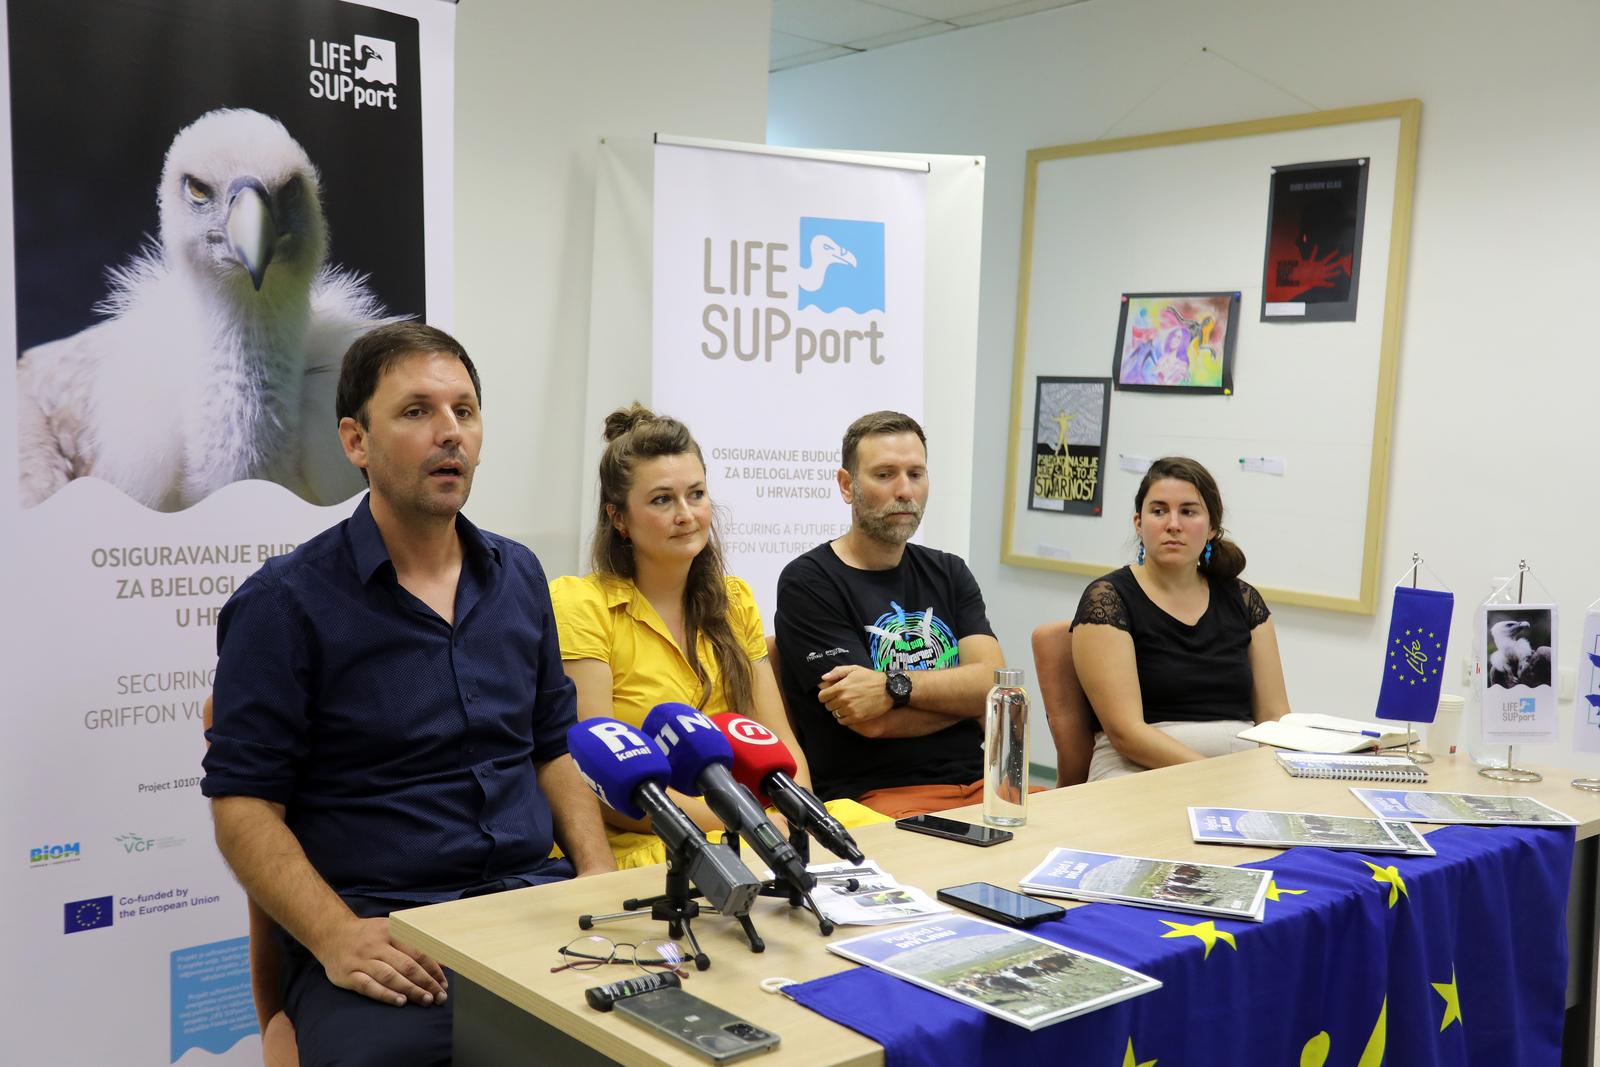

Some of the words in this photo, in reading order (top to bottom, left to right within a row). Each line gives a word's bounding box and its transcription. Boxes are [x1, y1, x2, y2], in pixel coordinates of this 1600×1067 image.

[310, 38, 352, 73] LIFE
[309, 70, 397, 110] SUPport
[704, 237, 789, 299] LIFE
[701, 303, 885, 374] SUPport
[712, 447, 798, 462] OSIGURAVANJE
[725, 467, 740, 479] ZA
[743, 467, 814, 481] BJELOGLAVE
[756, 486, 764, 498] U
[768, 486, 831, 499] HRVATSKOJ
[724, 523, 780, 536] SECURING
[783, 523, 792, 535] A
[794, 523, 836, 536] FUTURE
[91, 544, 251, 569] OSIGURAVANJE
[116, 579, 144, 600] ZA
[176, 608, 190, 627] U
[84, 702, 176, 730] GRIFFON
[138, 782, 171, 793] Project
[124, 839, 155, 854] VCF
[119, 889, 173, 906] Co-funded
[176, 888, 189, 897] by
[119, 909, 136, 919] the
[138, 900, 188, 915] European
[190, 895, 220, 907] Union
